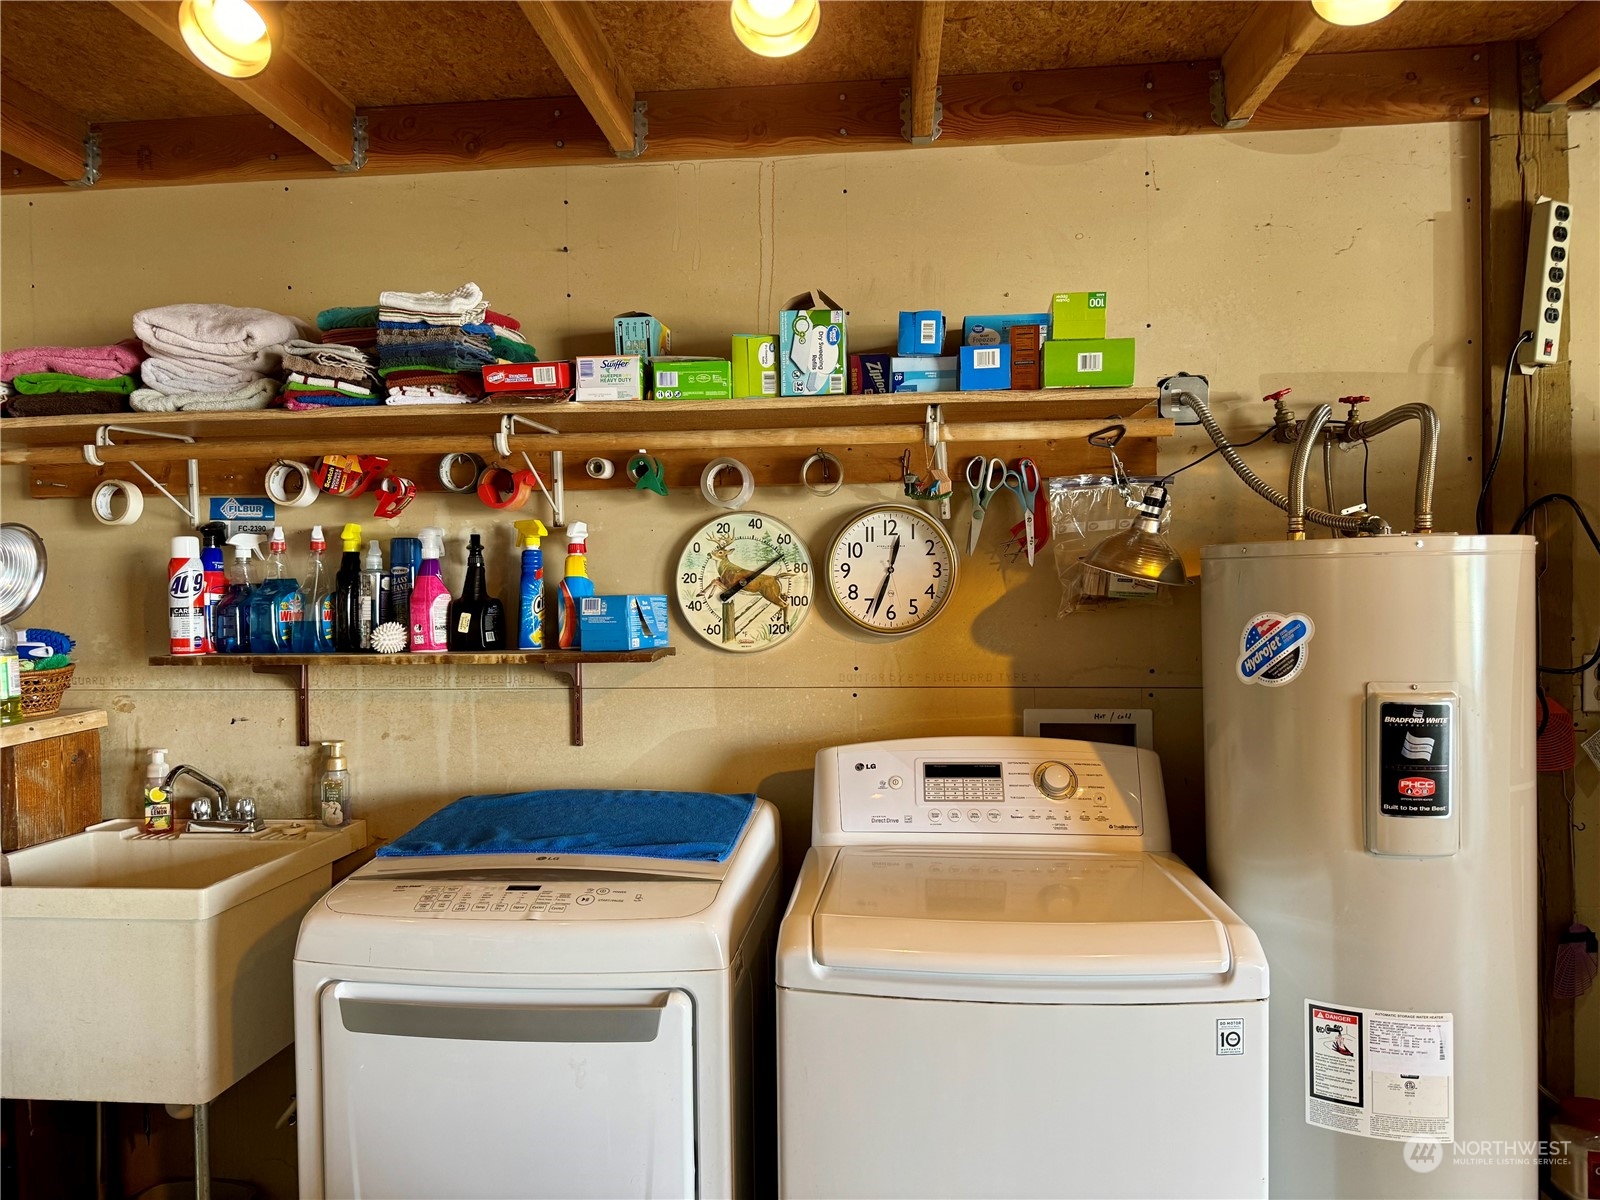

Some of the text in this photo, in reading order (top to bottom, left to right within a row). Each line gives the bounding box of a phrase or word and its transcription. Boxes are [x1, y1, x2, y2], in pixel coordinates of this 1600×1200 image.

[1089, 298, 1105, 307] 100
[600, 359, 630, 370] Swiffer
[865, 361, 886, 393] Ziploc
[797, 381, 804, 392] 32
[323, 467, 335, 488] Scotch
[716, 523, 730, 534] 20
[748, 518, 763, 529] 40
[884, 519, 899, 536] 12
[776, 534, 791, 545] 60
[865, 526, 874, 542] 11
[693, 542, 701, 553] 0
[848, 542, 863, 558] 10
[925, 539, 936, 556] 2
[793, 562, 808, 574] 80
[840, 562, 851, 579] 9
[932, 562, 942, 578] 3
[170, 572, 203, 594] 409
[681, 572, 697, 584] -20
[848, 584, 859, 600] 8
[924, 583, 935, 599] 4
[685, 600, 702, 611] -40
[790, 595, 808, 606] 100
[864, 598, 875, 614] 7
[908, 599, 918, 615] 5
[886, 604, 896, 620] 6
[703, 624, 721, 635] -60
[1244, 635, 1282, 673] Hydrojet
[925, 672, 993, 682] FIREGUARD
[1000, 672, 1028, 682] TYPE
[1384, 716, 1425, 724] BRADFORD
[1400, 780, 1434, 788] PHCC
[1325, 1013, 1352, 1023] DANGER
[1220, 1031, 1241, 1048] 10
